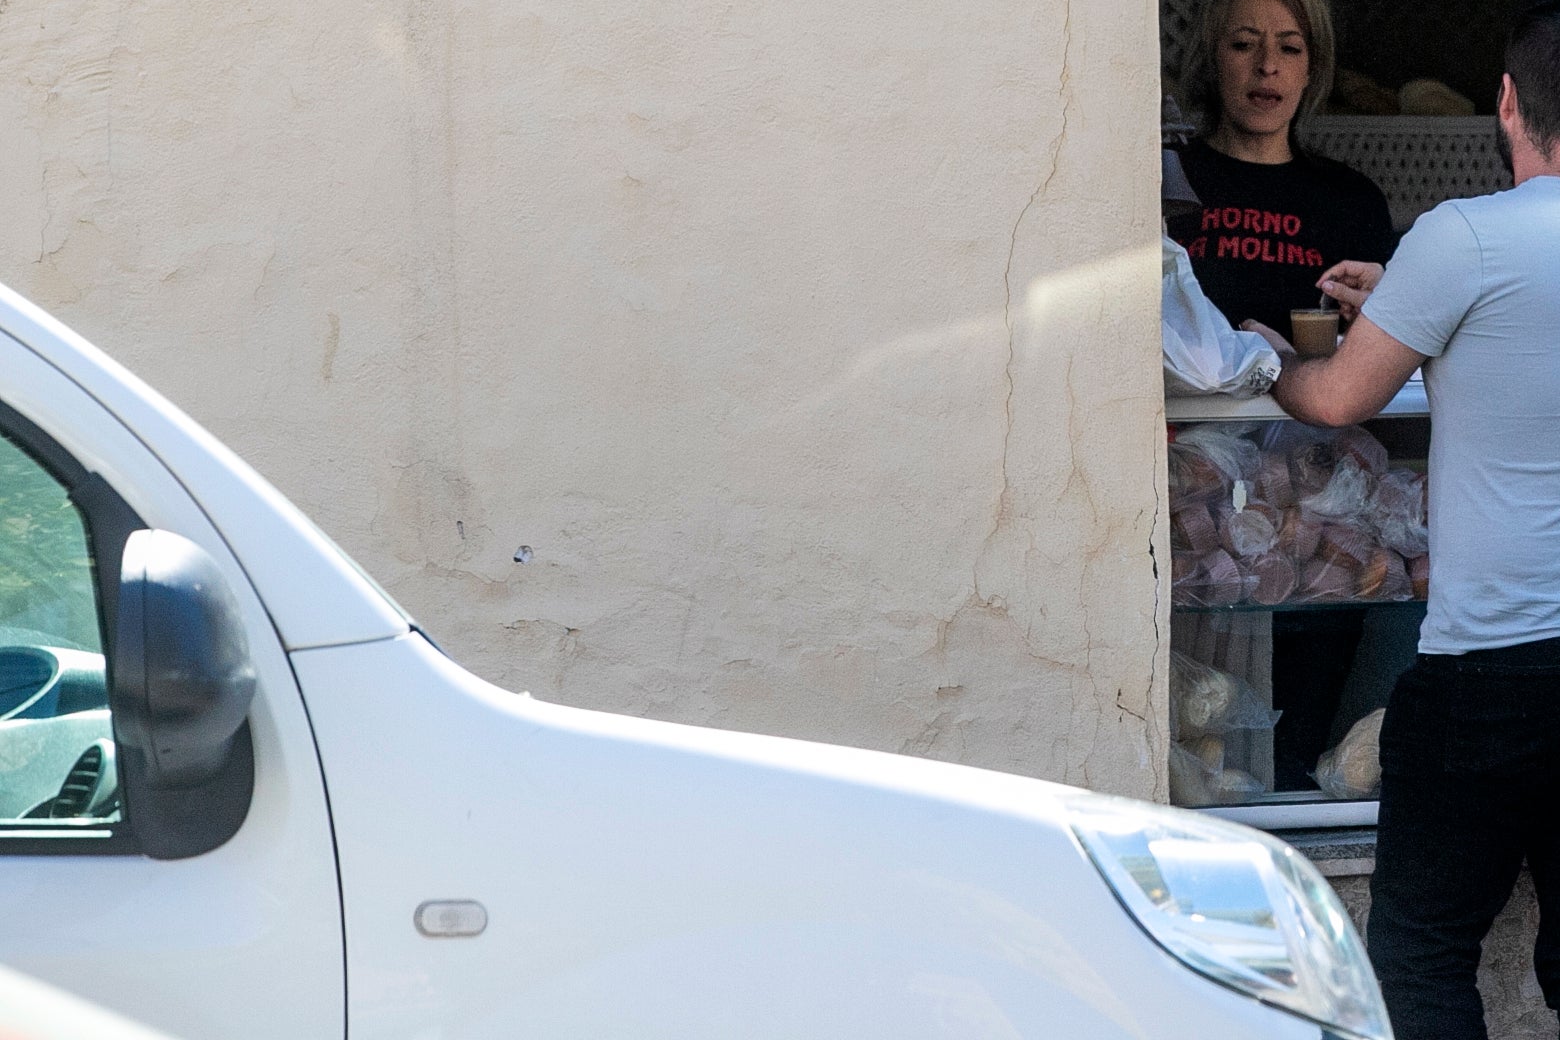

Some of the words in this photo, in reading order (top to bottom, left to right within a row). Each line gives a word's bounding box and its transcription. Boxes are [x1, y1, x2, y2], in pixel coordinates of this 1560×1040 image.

[1202, 208, 1302, 235] HORNO
[1178, 237, 1207, 258] A
[1218, 237, 1323, 266] MOLINA
